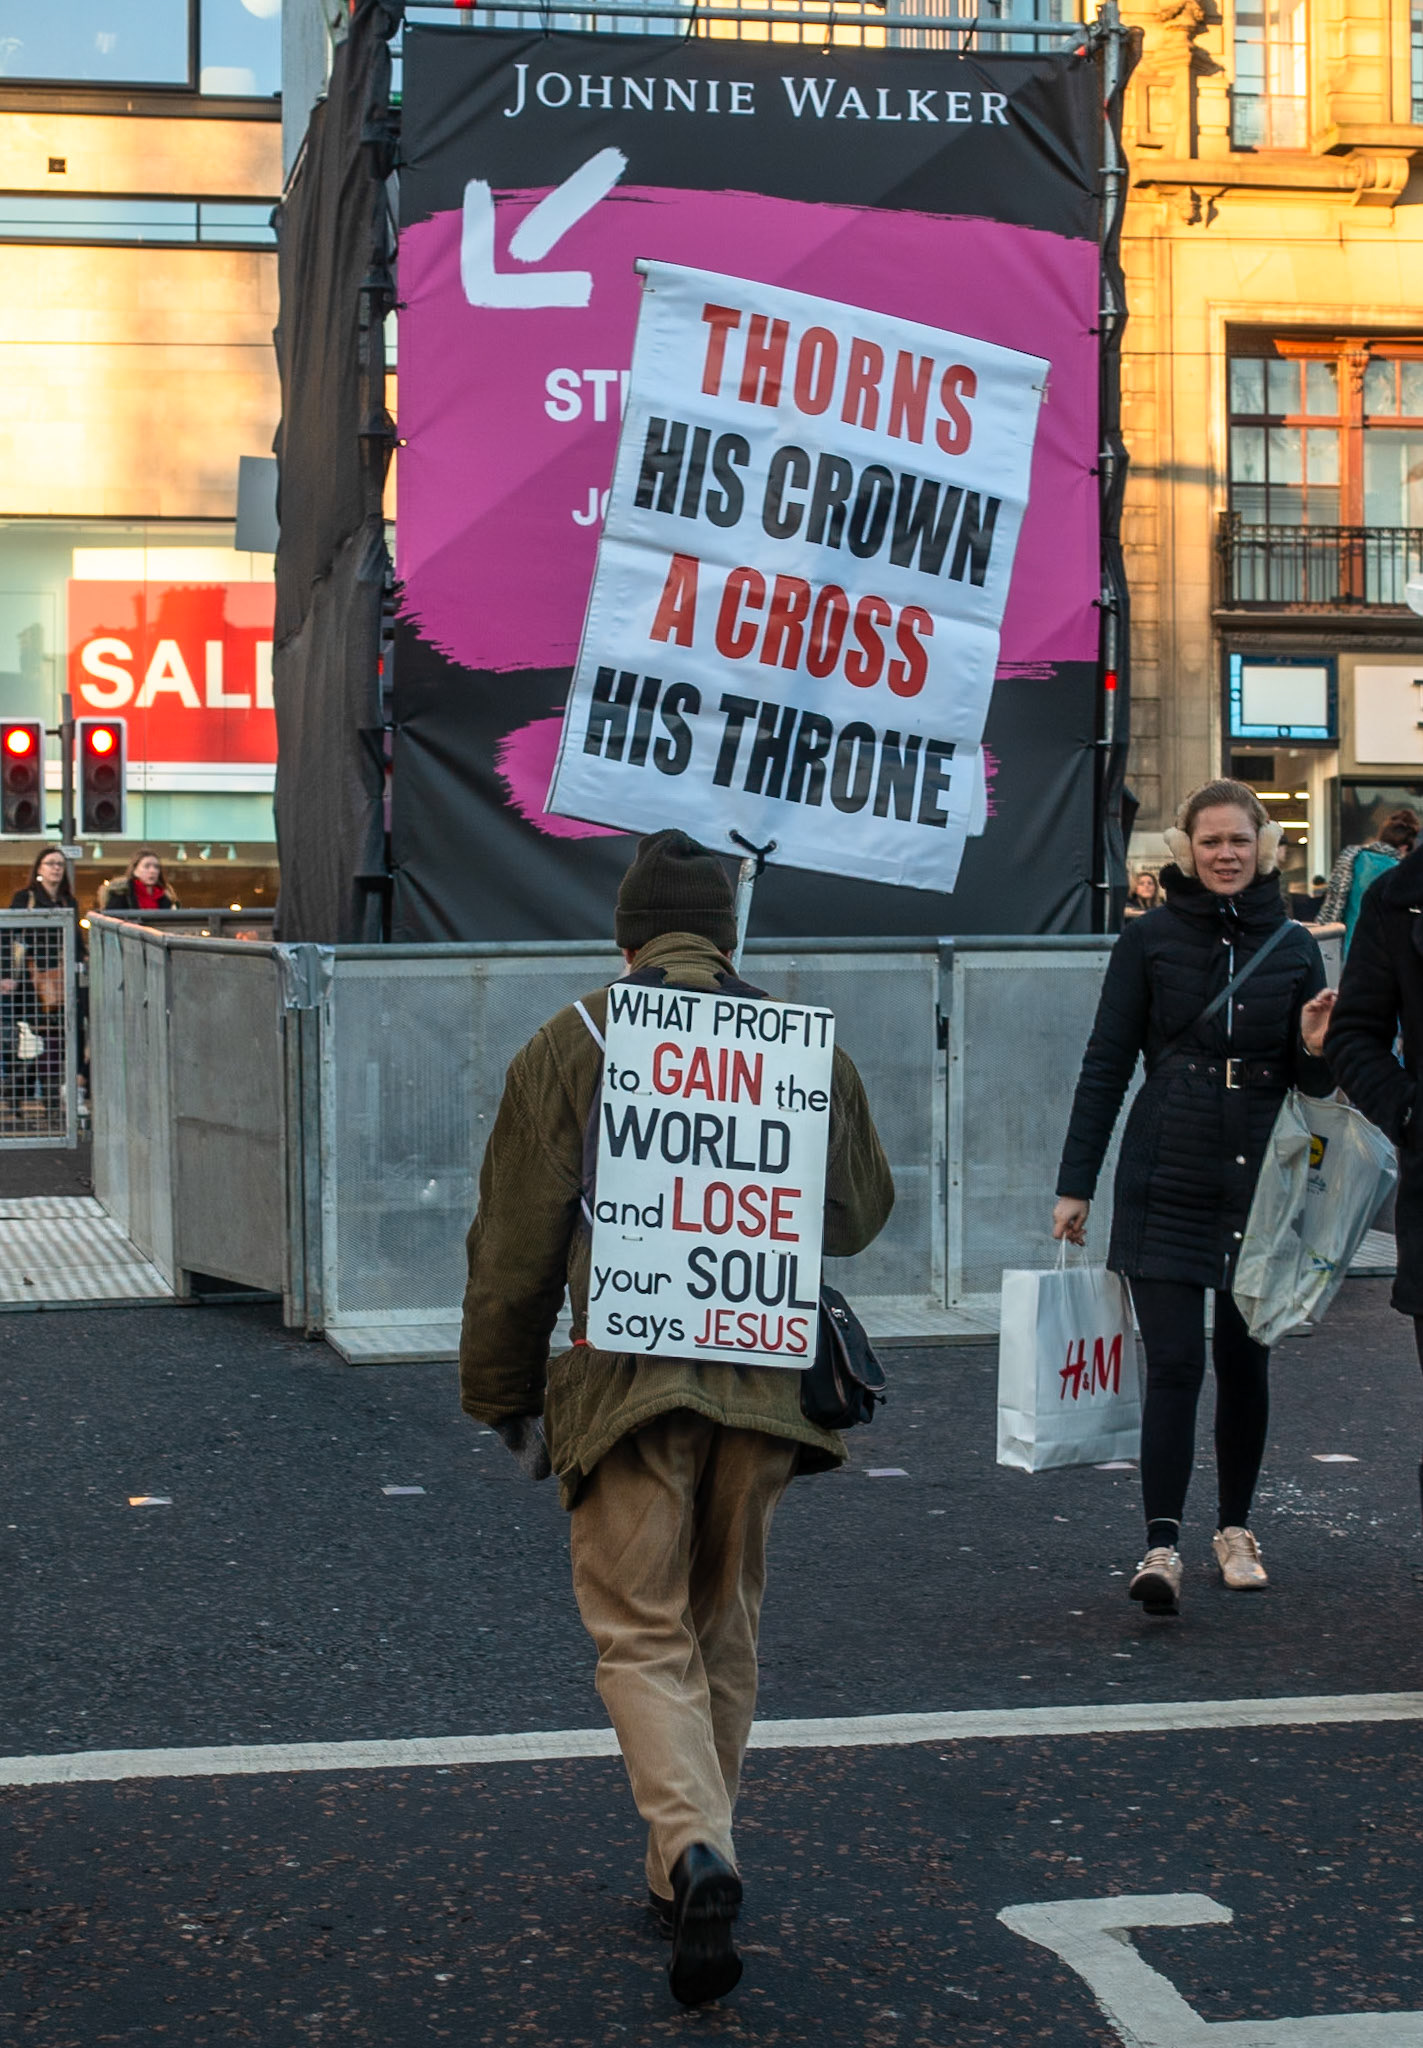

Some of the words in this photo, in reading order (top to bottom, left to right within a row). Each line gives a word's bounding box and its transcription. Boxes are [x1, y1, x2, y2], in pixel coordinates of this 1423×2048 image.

[700, 302, 978, 456] THORNS
[633, 416, 751, 529] HIS
[761, 445, 1003, 589] CROWN
[649, 552, 701, 649] A
[714, 566, 935, 698] CROSS
[582, 665, 702, 776] HIS
[711, 692, 958, 829] THRONE
[609, 987, 702, 1033] WHAT
[712, 1000, 836, 1049] PROFIT
[607, 1062, 641, 1092] to
[651, 1041, 764, 1106] GAIN
[774, 1074, 829, 1112] the
[603, 1102, 791, 1174] WORLD
[594, 1193, 664, 1228] and
[671, 1176, 802, 1242] LOSE
[590, 1264, 672, 1302] your
[686, 1246, 818, 1310] SOUL
[606, 1312, 685, 1351] says
[694, 1308, 809, 1354] JESUS
[1058, 1332, 1122, 1401] H&M
